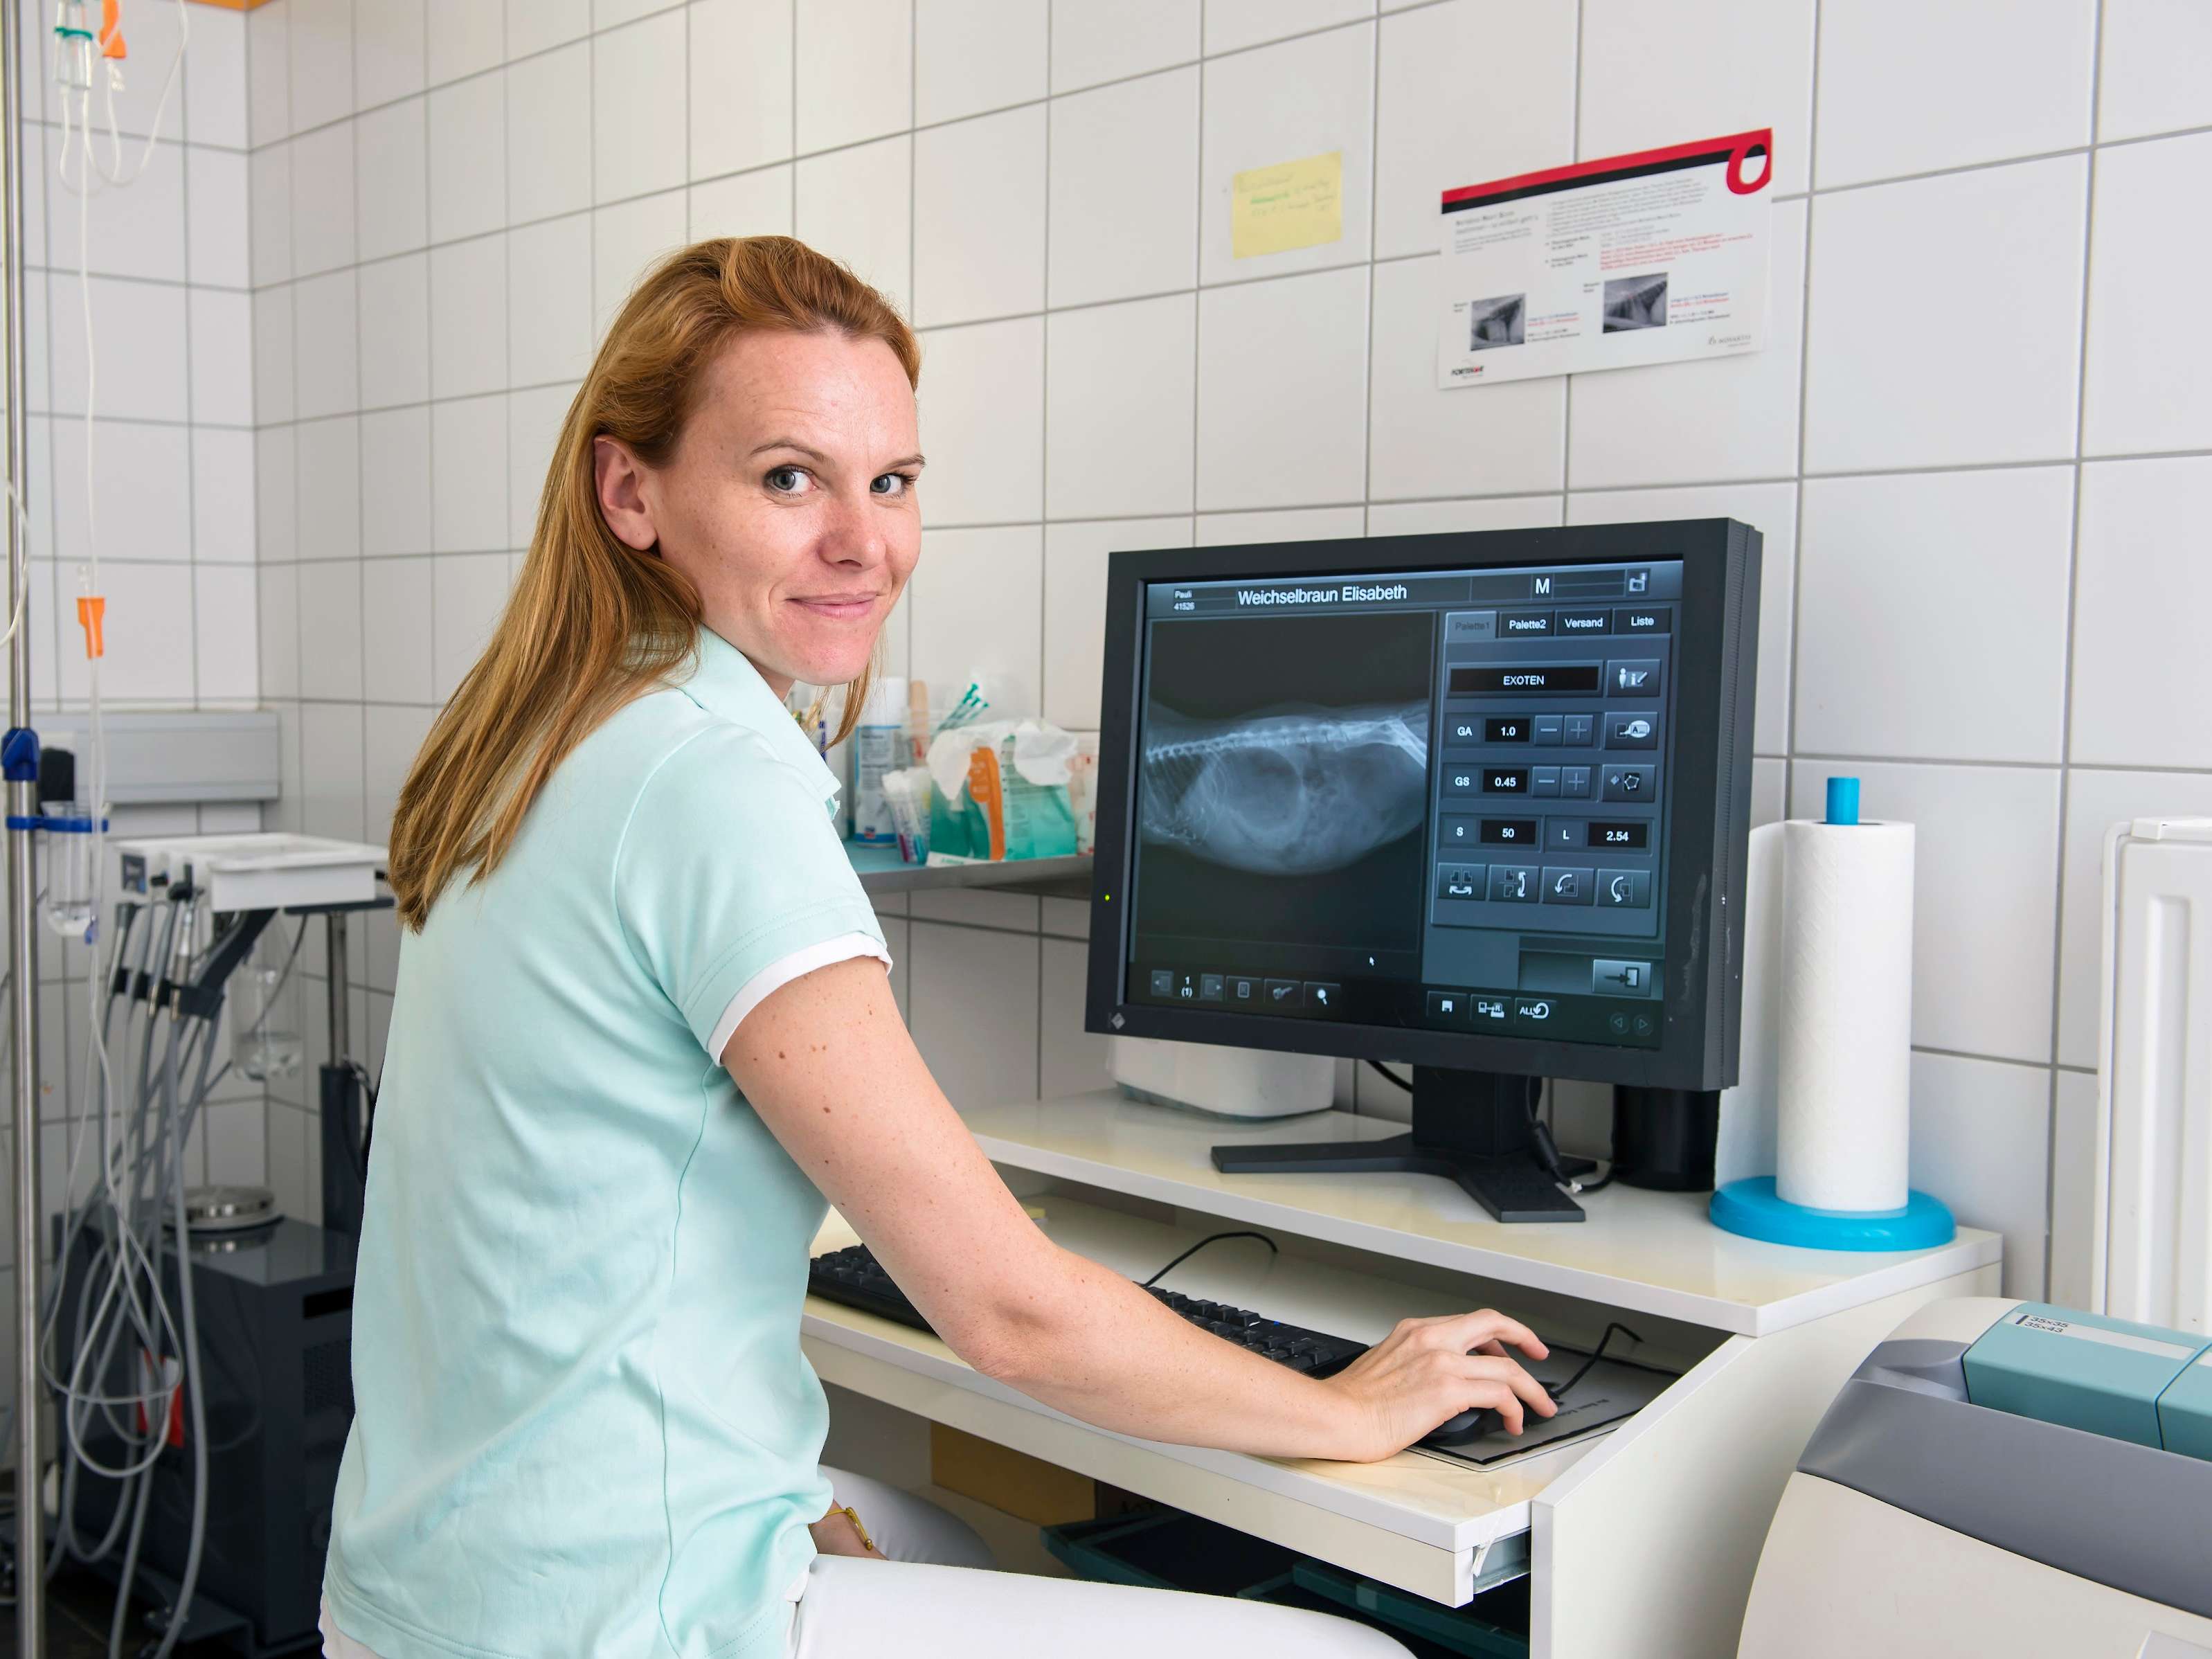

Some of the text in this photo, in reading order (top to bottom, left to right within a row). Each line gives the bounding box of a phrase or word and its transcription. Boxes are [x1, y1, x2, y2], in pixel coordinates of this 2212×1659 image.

[1535, 577, 1550, 594] M
[1238, 584, 1408, 605] Weichselbraun Elisabeth
[1509, 619, 1547, 630] Palette2
[1565, 617, 1603, 628] Versand
[1630, 616, 1655, 627] Liste
[1503, 675, 1545, 685] EXOTEN
[1457, 726, 1473, 737] GA
[1501, 726, 1516, 737] 1.0
[1455, 776, 1470, 787] GS
[1494, 777, 1516, 787] 0.45
[1456, 826, 1464, 837] S
[1502, 827, 1515, 839] 50
[1563, 830, 1570, 840] L
[1606, 830, 1629, 841] 2.54
[1185, 976, 1190, 985] 1
[1519, 1006, 1534, 1016] ALL
[2024, 1322, 2063, 1333] 35x43
[2031, 1317, 2069, 1327] 35x35
